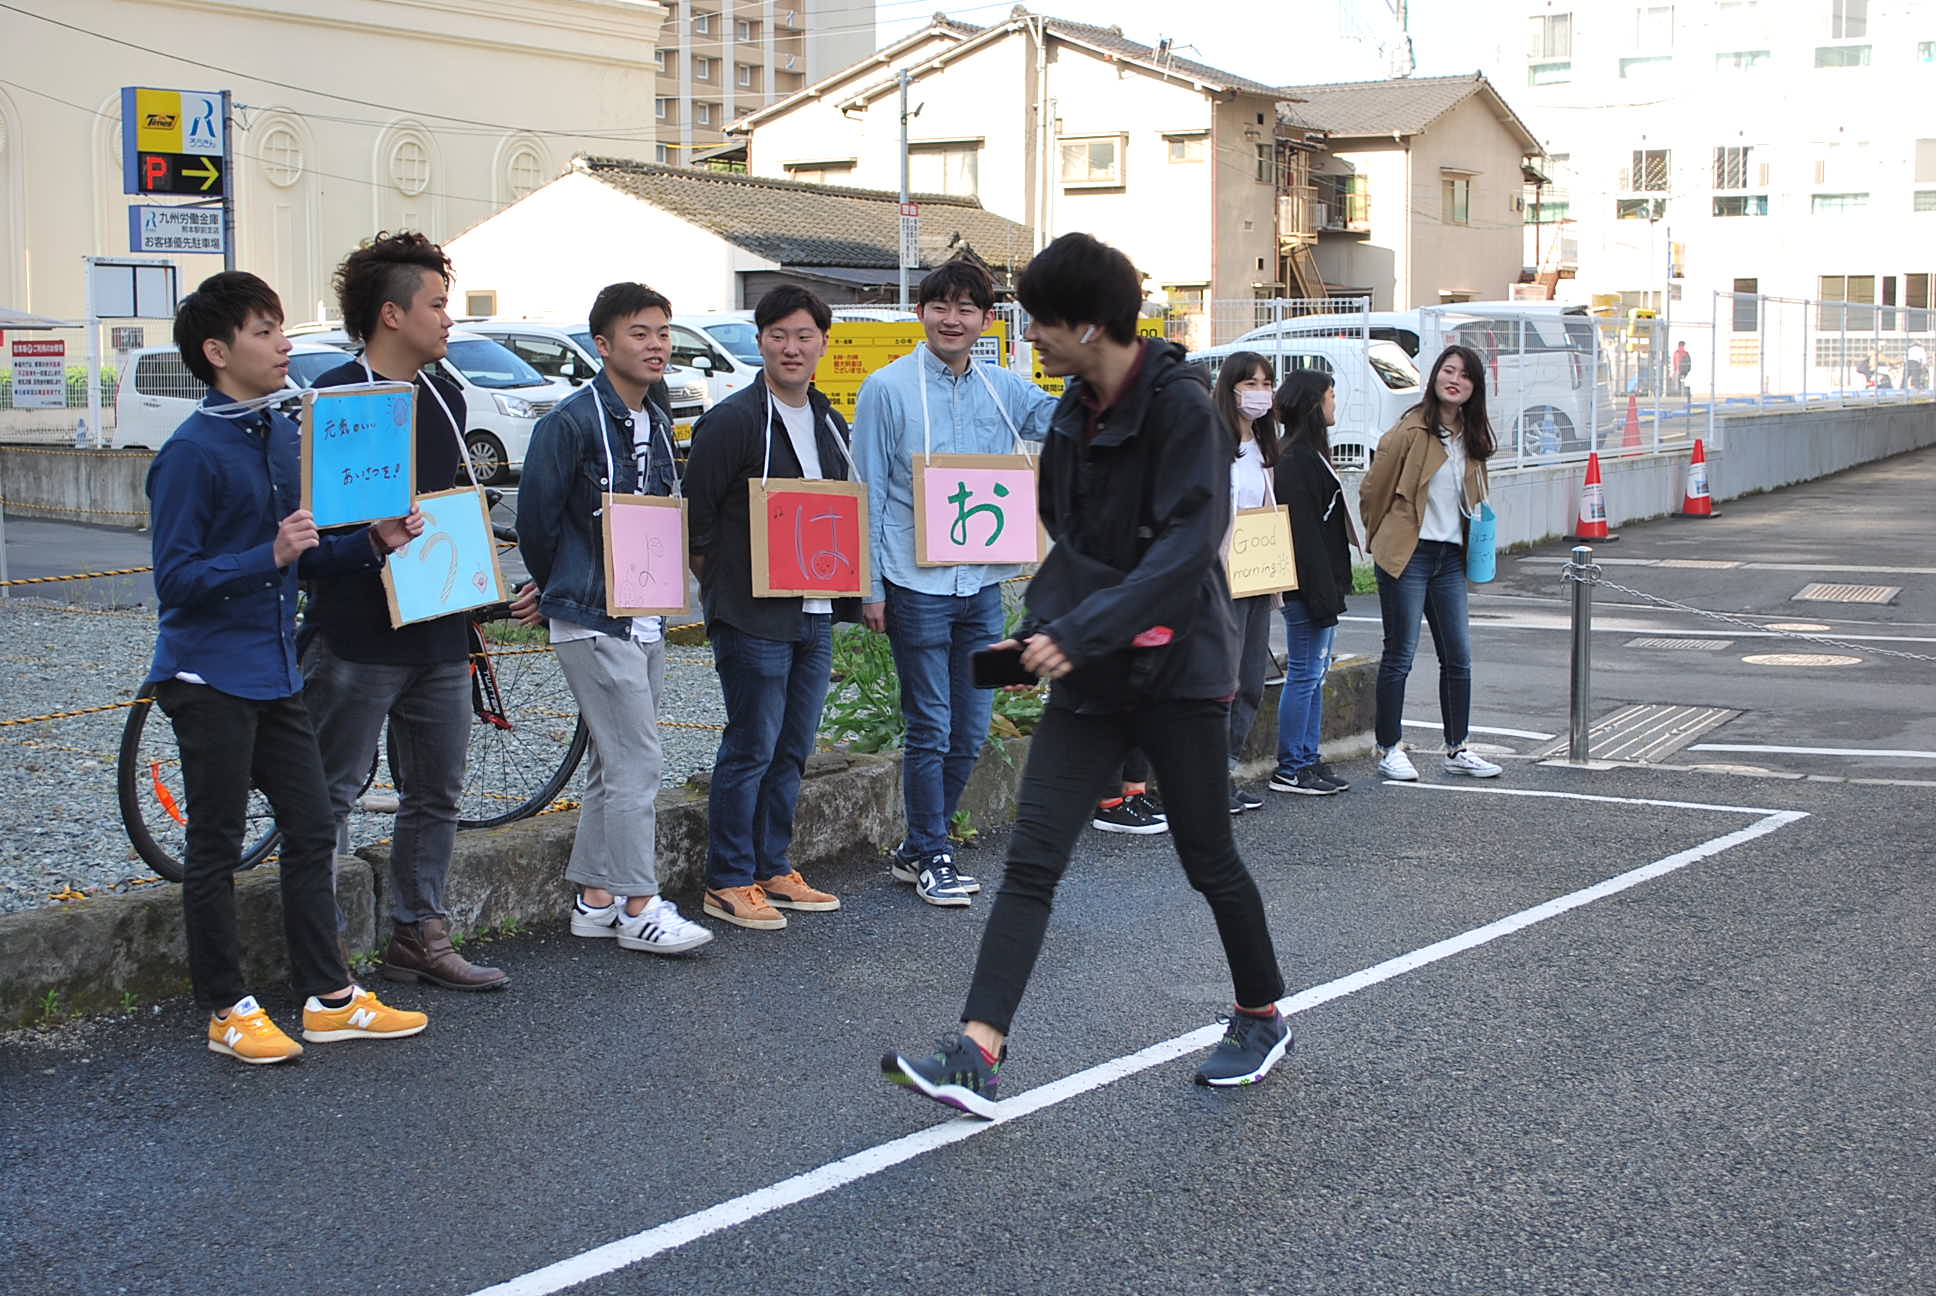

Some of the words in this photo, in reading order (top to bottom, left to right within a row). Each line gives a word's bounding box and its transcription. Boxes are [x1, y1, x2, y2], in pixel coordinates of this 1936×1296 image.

[146, 157, 168, 190] P
[159, 212, 219, 225] 九州労働金庫
[144, 237, 220, 249] お客様優先駐車場
[947, 481, 1010, 547] お
[794, 504, 850, 581] は
[1232, 523, 1277, 555] Good
[1232, 562, 1277, 580] morning
